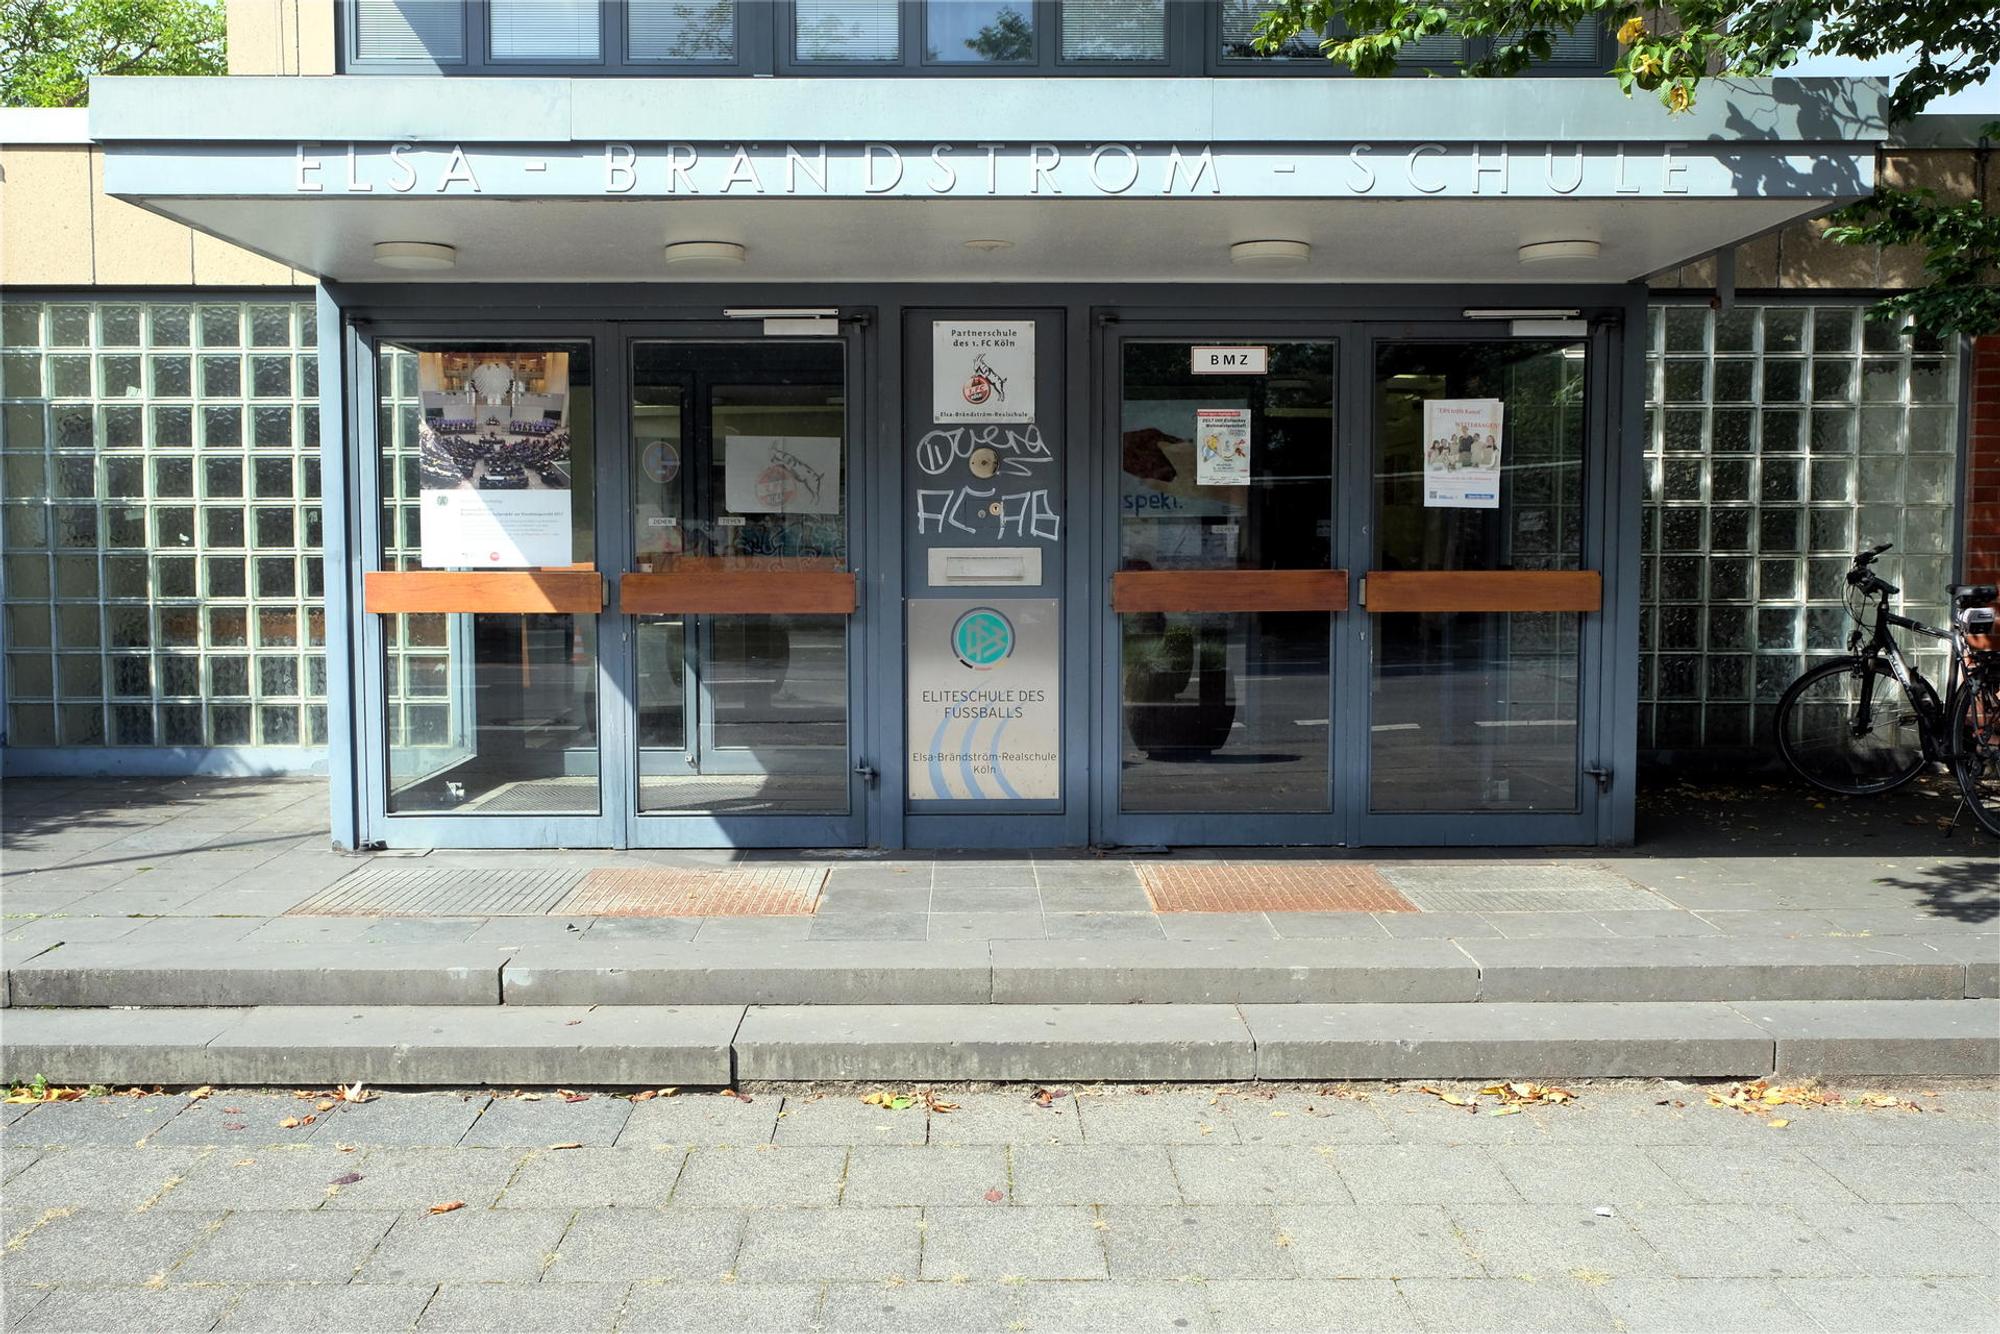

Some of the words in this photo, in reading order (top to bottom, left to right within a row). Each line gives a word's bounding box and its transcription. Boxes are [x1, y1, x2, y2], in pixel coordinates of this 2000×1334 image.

[296, 143, 482, 193] ELSA
[604, 143, 1221, 194] BRÄNDSTRÖM
[1346, 143, 1689, 194] SCHULE
[951, 329, 1018, 337] Partnerschule
[953, 339, 969, 347] des
[981, 339, 991, 347] FC
[994, 339, 1016, 347] Köln
[922, 690, 1014, 703] ELITESCHULE
[1018, 690, 1045, 702] DES
[944, 707, 1023, 719] FUSSBALLS
[912, 753, 1057, 762] Elsa-Brändström-Realschule
[973, 764, 996, 775] Köln
